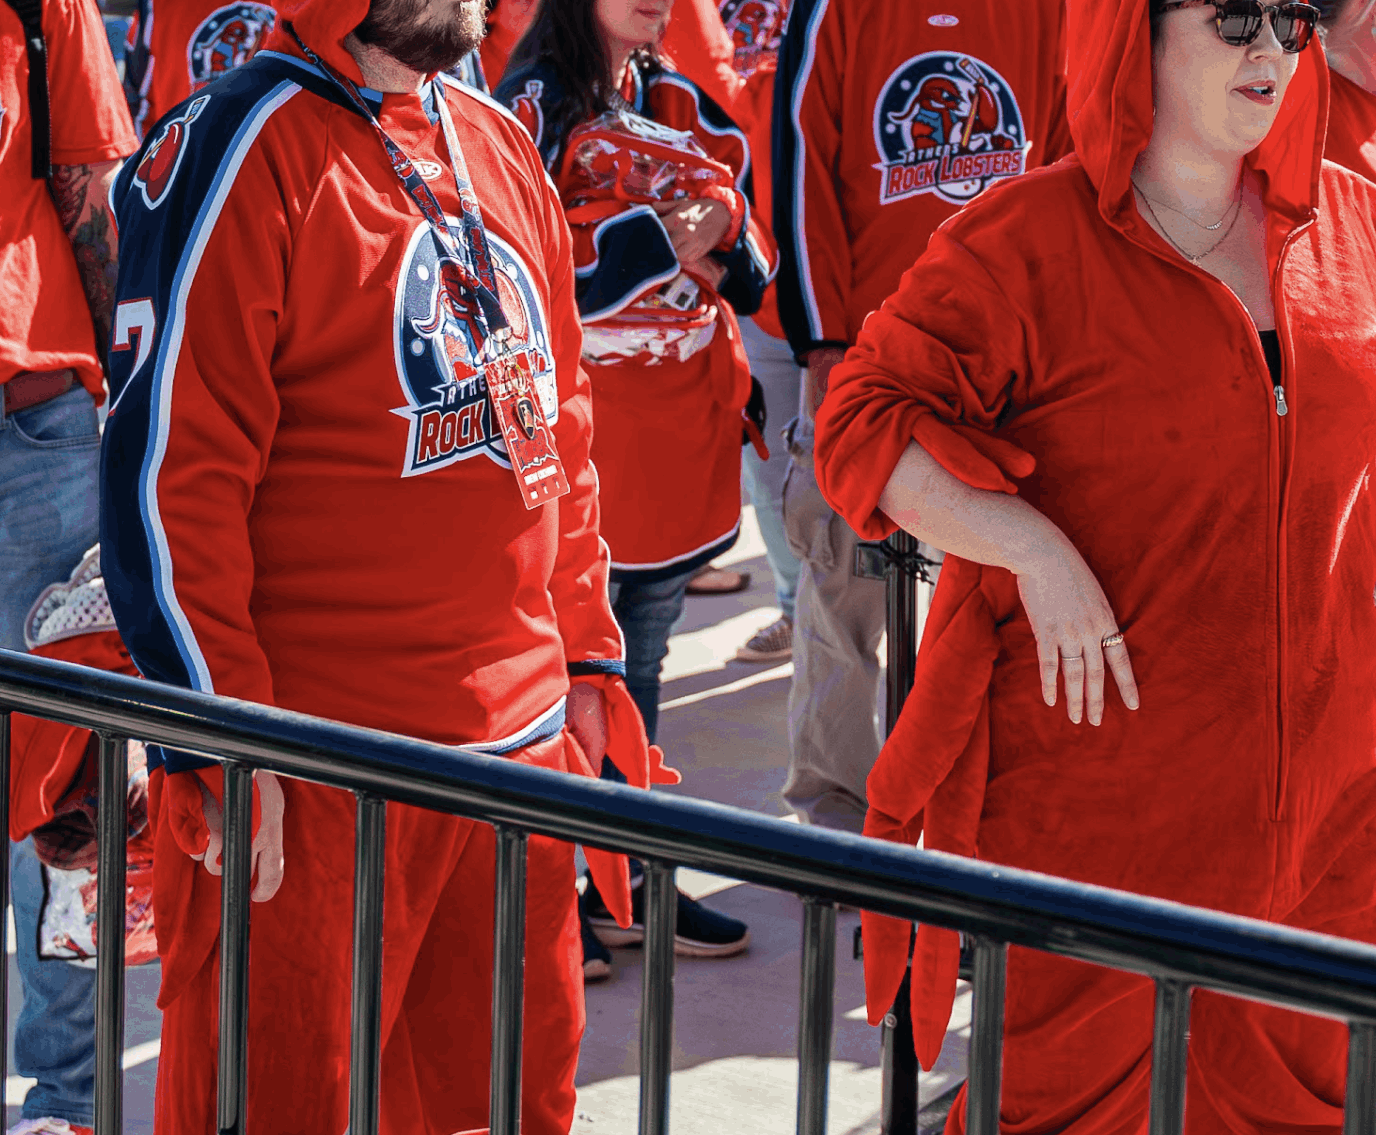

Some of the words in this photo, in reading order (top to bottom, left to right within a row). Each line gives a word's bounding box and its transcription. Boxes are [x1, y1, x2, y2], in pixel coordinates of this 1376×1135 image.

[908, 143, 959, 163] ATHENS
[888, 160, 939, 196] ROCK
[939, 150, 1022, 183] LOBSTERS
[447, 376, 486, 405] ATHE
[416, 398, 486, 464] ROCK
